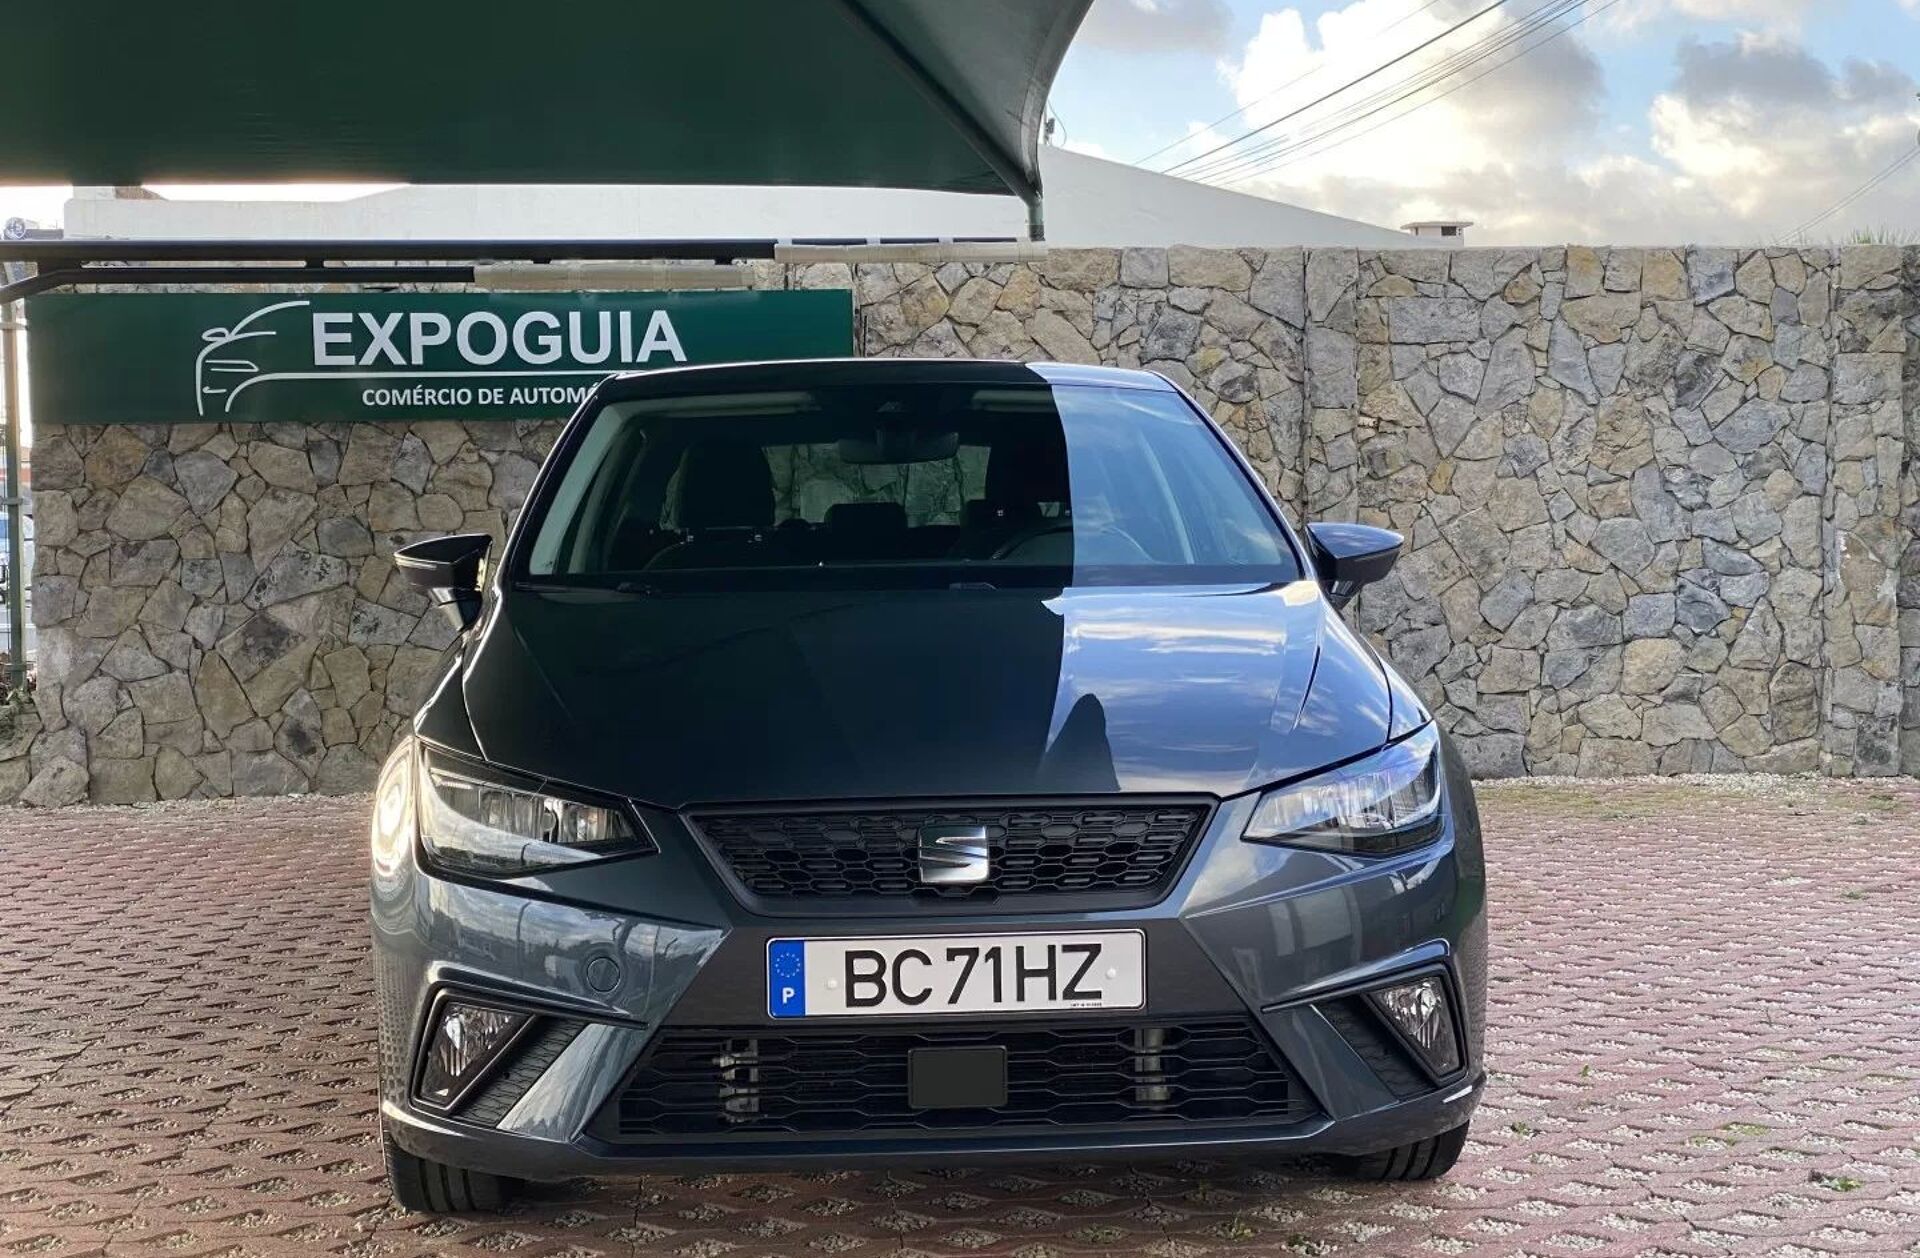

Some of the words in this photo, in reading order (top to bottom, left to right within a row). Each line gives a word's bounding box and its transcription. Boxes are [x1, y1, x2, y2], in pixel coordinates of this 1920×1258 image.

[312, 309, 688, 366] EXPOGUIA
[362, 384, 472, 406] COMÉRCIO
[478, 388, 504, 405] DE
[782, 987, 795, 1004] P
